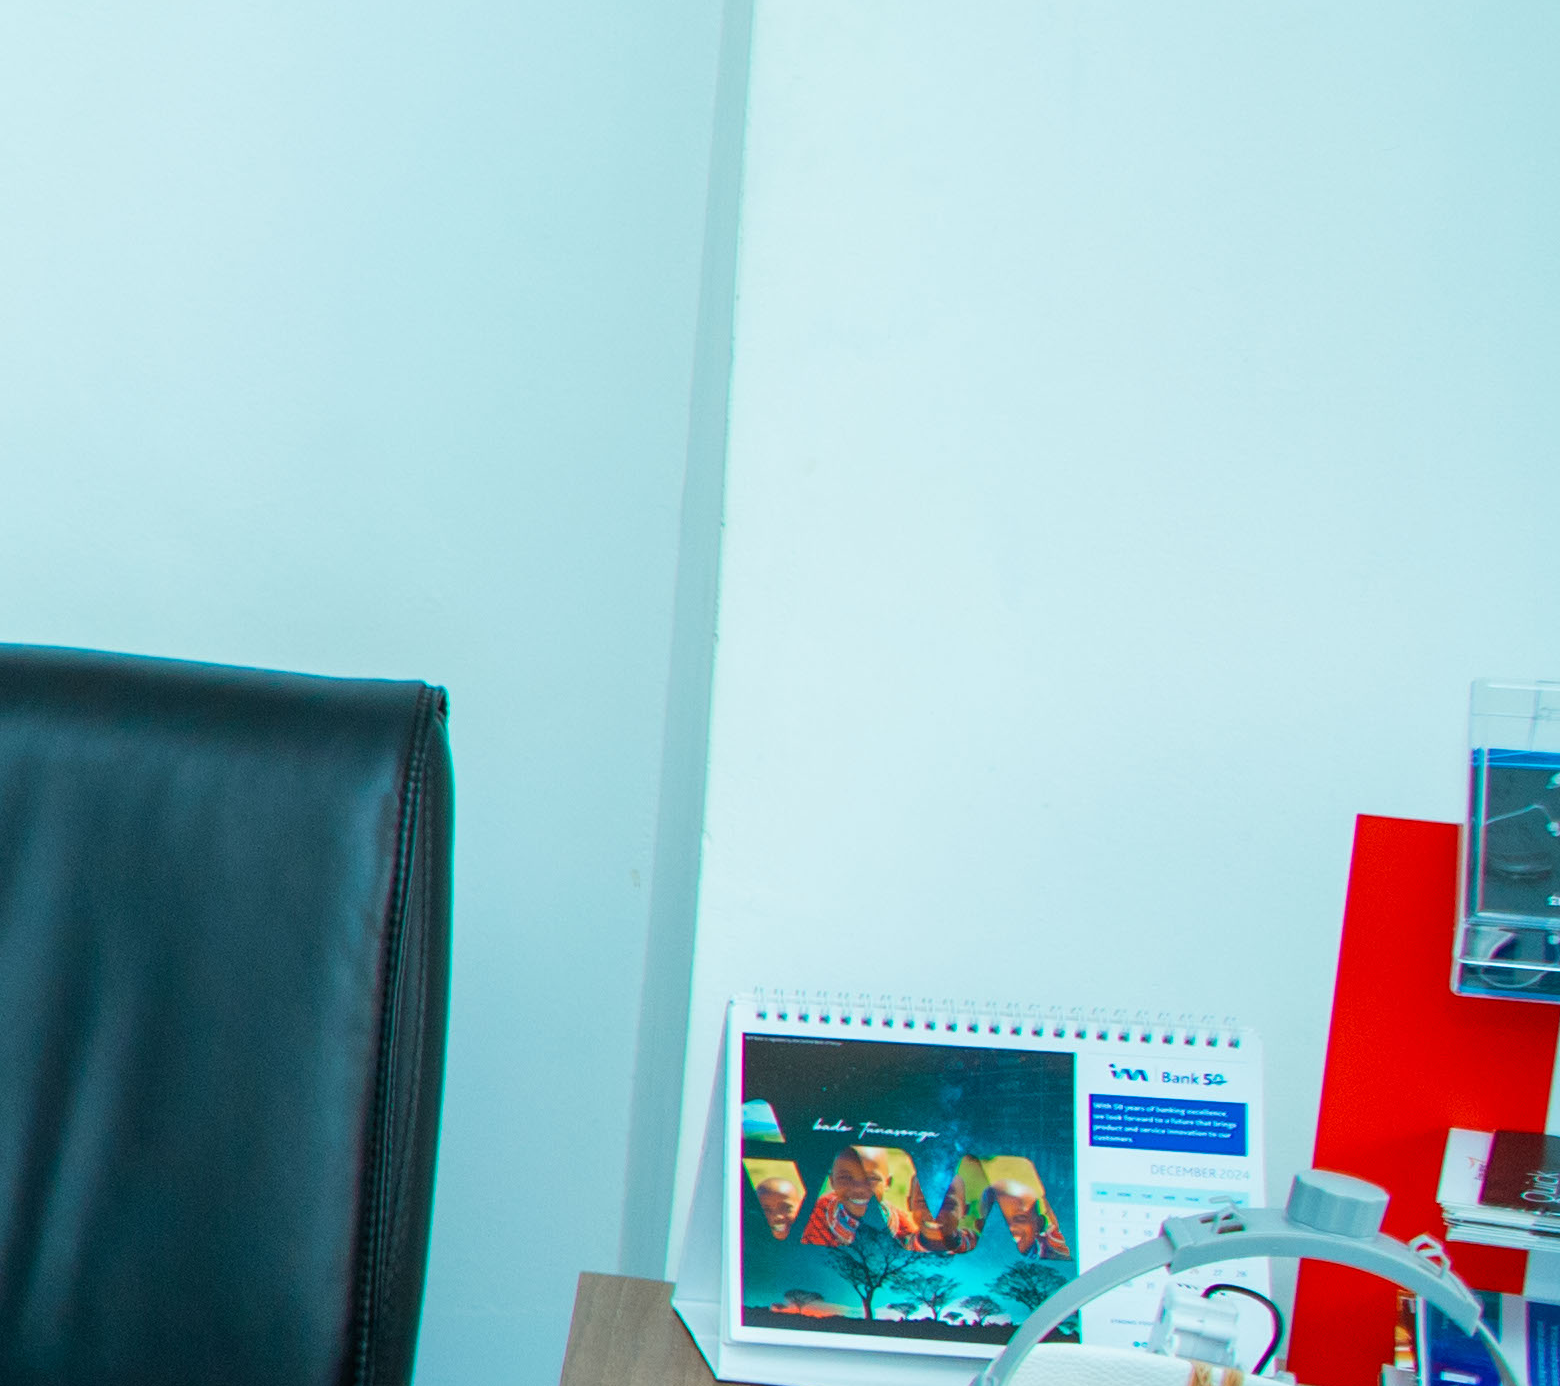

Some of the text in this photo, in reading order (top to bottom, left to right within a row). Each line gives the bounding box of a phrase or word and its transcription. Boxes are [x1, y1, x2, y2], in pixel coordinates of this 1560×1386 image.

[1162, 1071, 1200, 1085] Bank
[1124, 1104, 1145, 1113] years
[1155, 1105, 1186, 1116] banking
[1105, 1113, 1122, 1121] look
[1123, 1114, 1154, 1123] forward
[1170, 1117, 1194, 1126] future
[1195, 1119, 1212, 1127] that
[1213, 1120, 1237, 1130] brings
[1093, 1124, 1122, 1133] product
[1124, 1125, 1139, 1133] and
[1140, 1126, 1166, 1134] service
[1166, 1127, 1208, 1137] innovation
[1218, 1131, 1232, 1139] our
[1150, 1164, 1251, 1181] DECEMBER 2024
